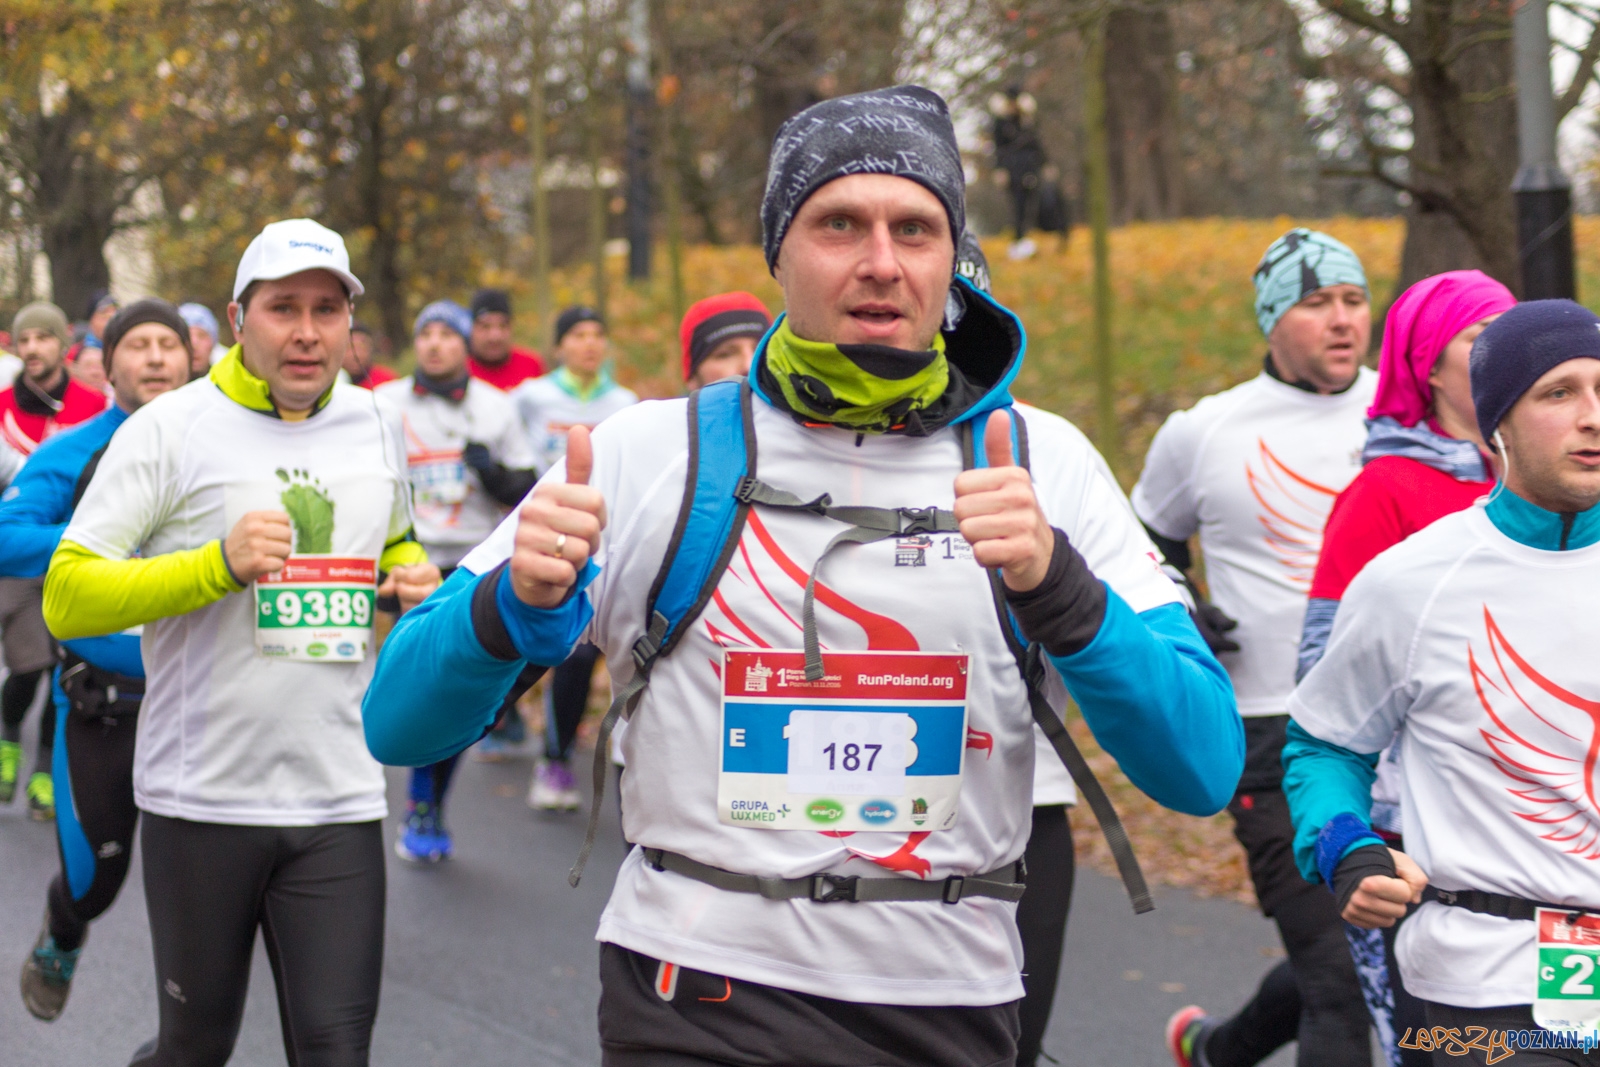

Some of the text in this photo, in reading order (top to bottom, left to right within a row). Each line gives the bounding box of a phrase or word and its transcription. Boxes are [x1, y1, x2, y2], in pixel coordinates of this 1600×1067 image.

[837, 113, 898, 138] Fifty
[838, 153, 898, 175] Fifty
[941, 536, 955, 559] 1
[260, 591, 370, 626] C 9389
[776, 667, 788, 687] 1
[857, 673, 954, 690] RunPoland.org
[729, 727, 747, 748] E
[822, 742, 883, 772] 187
[730, 800, 769, 812] GRUPA
[730, 811, 776, 823] LUXMED
[1540, 954, 1600, 995] C 2
